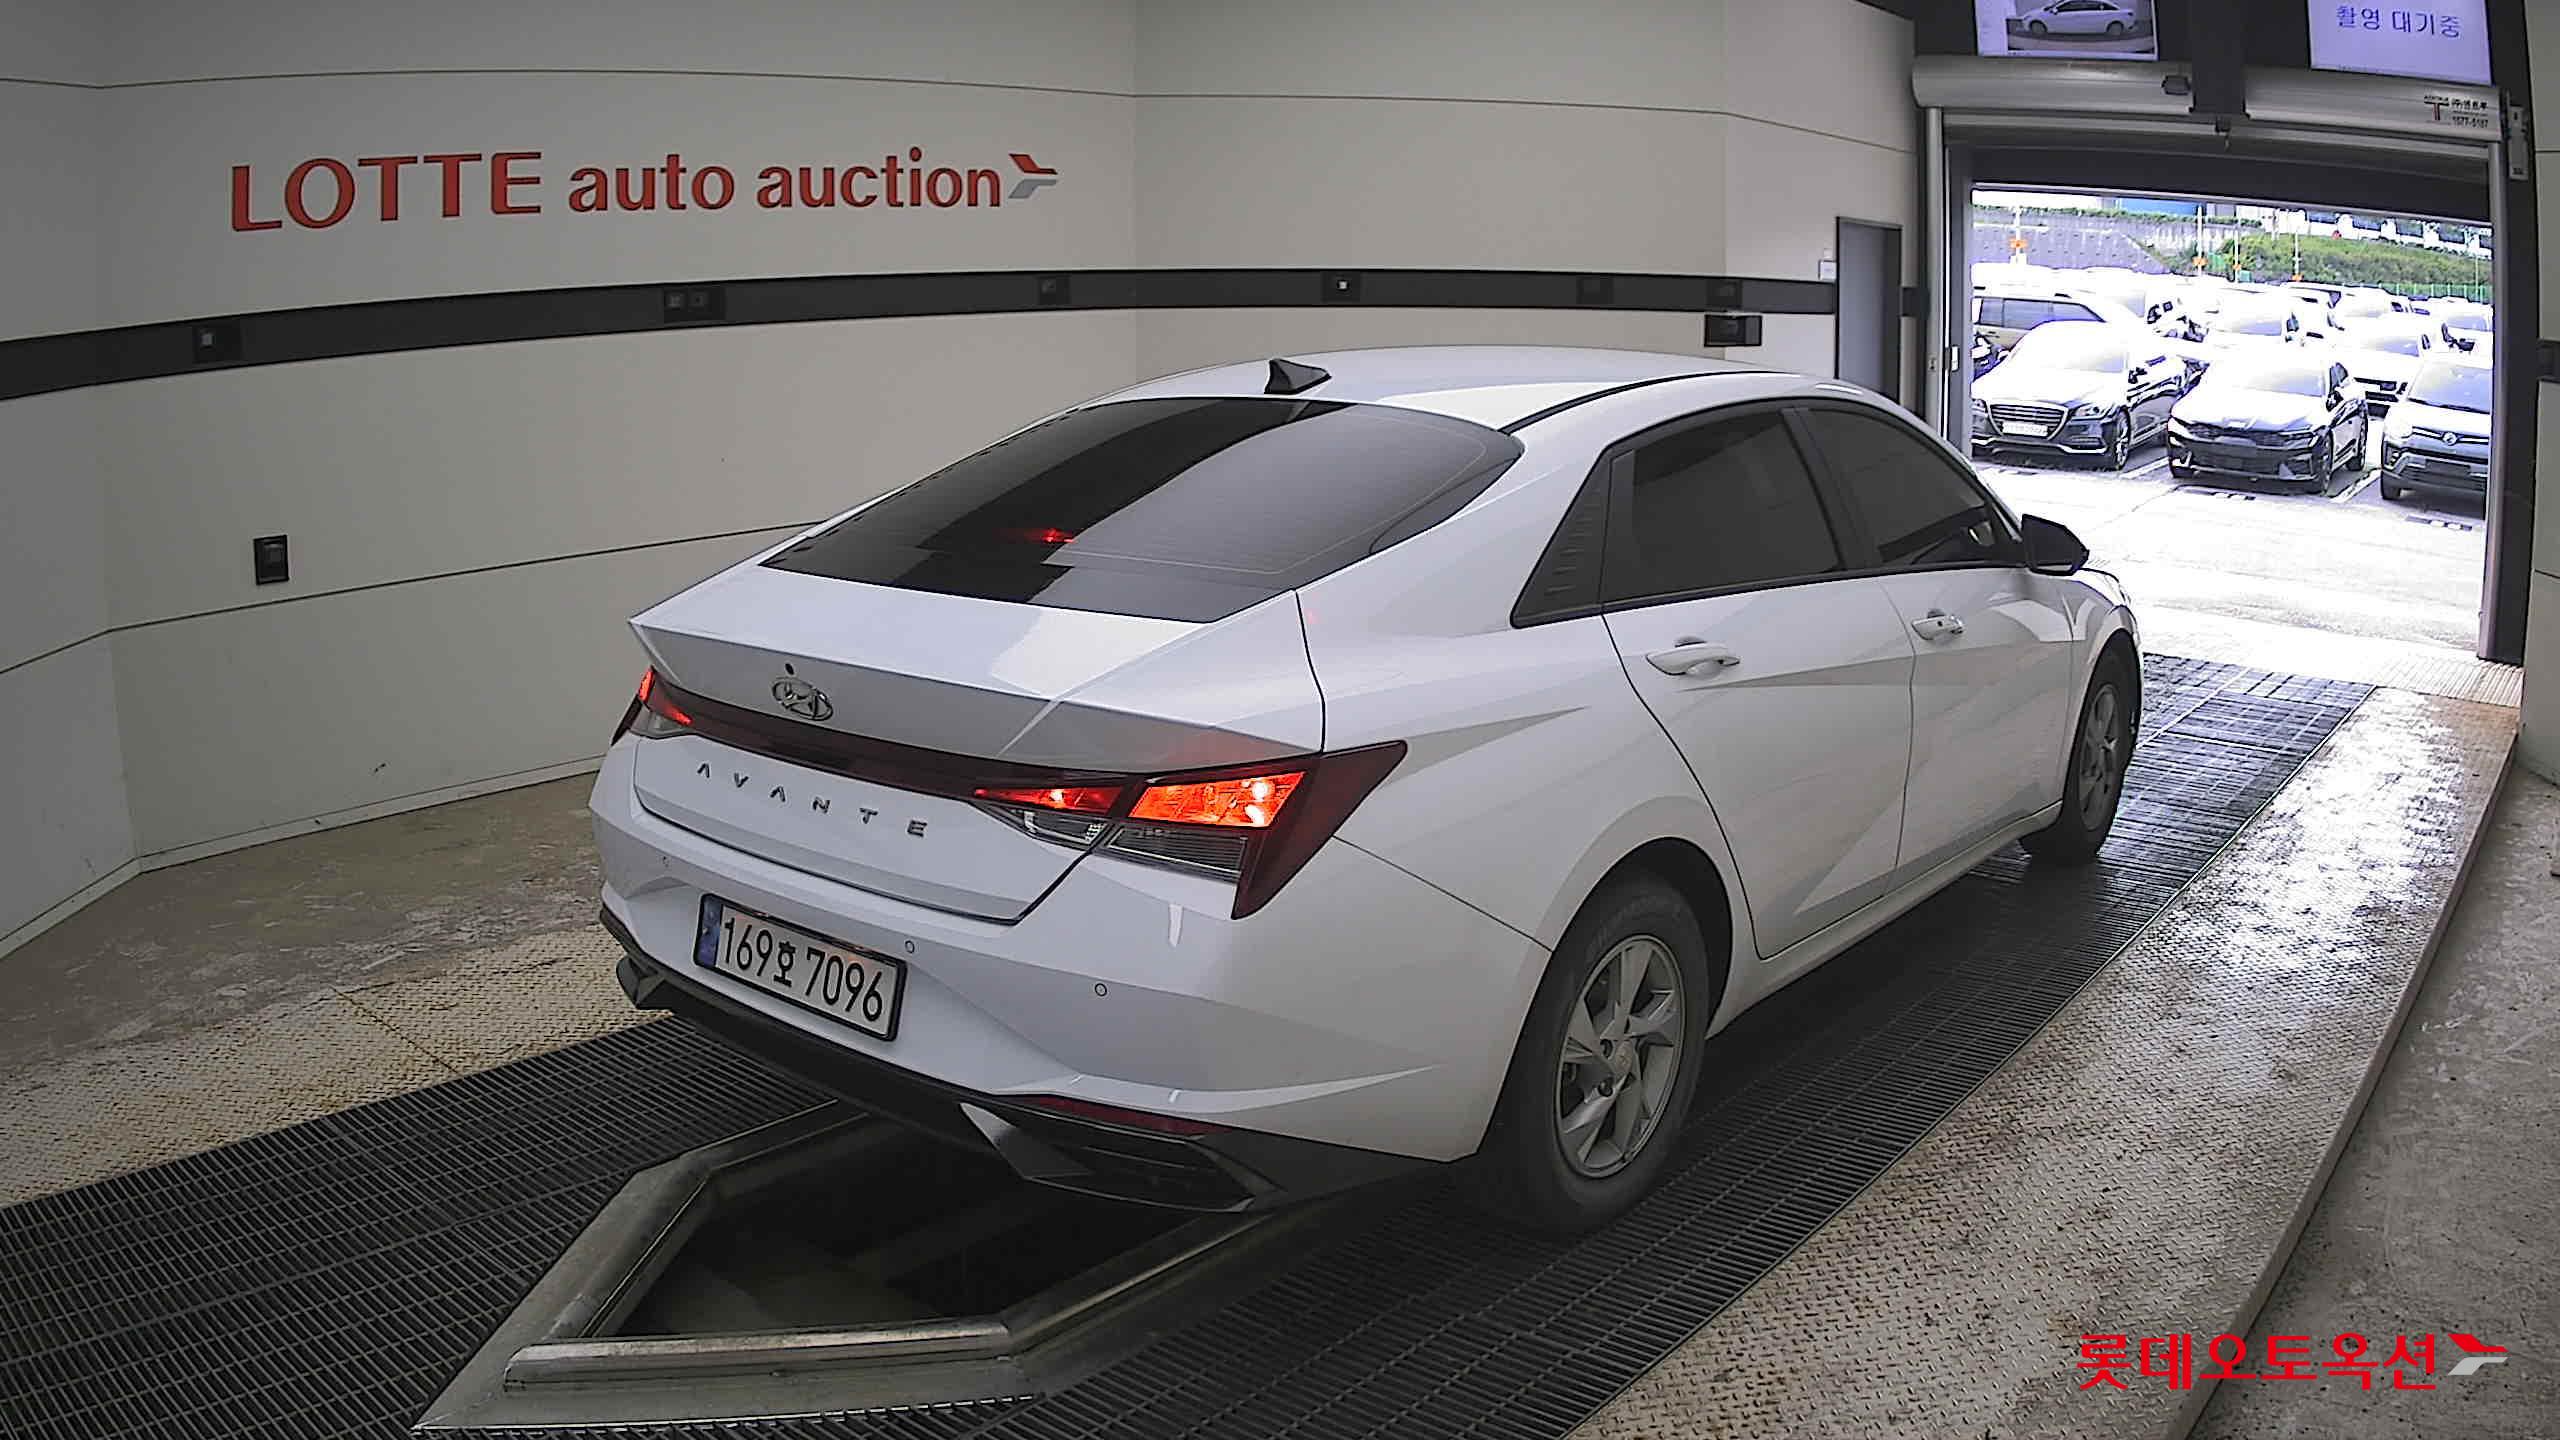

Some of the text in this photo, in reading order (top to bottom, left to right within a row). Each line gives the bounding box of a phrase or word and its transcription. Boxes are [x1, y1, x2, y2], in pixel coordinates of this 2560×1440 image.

[2336, 5, 2462, 39] 촬영 대기중
[230, 147, 1001, 232] LOTTE auto auction
[696, 762, 929, 838] AVANTE
[804, 948, 884, 1023] 7096
